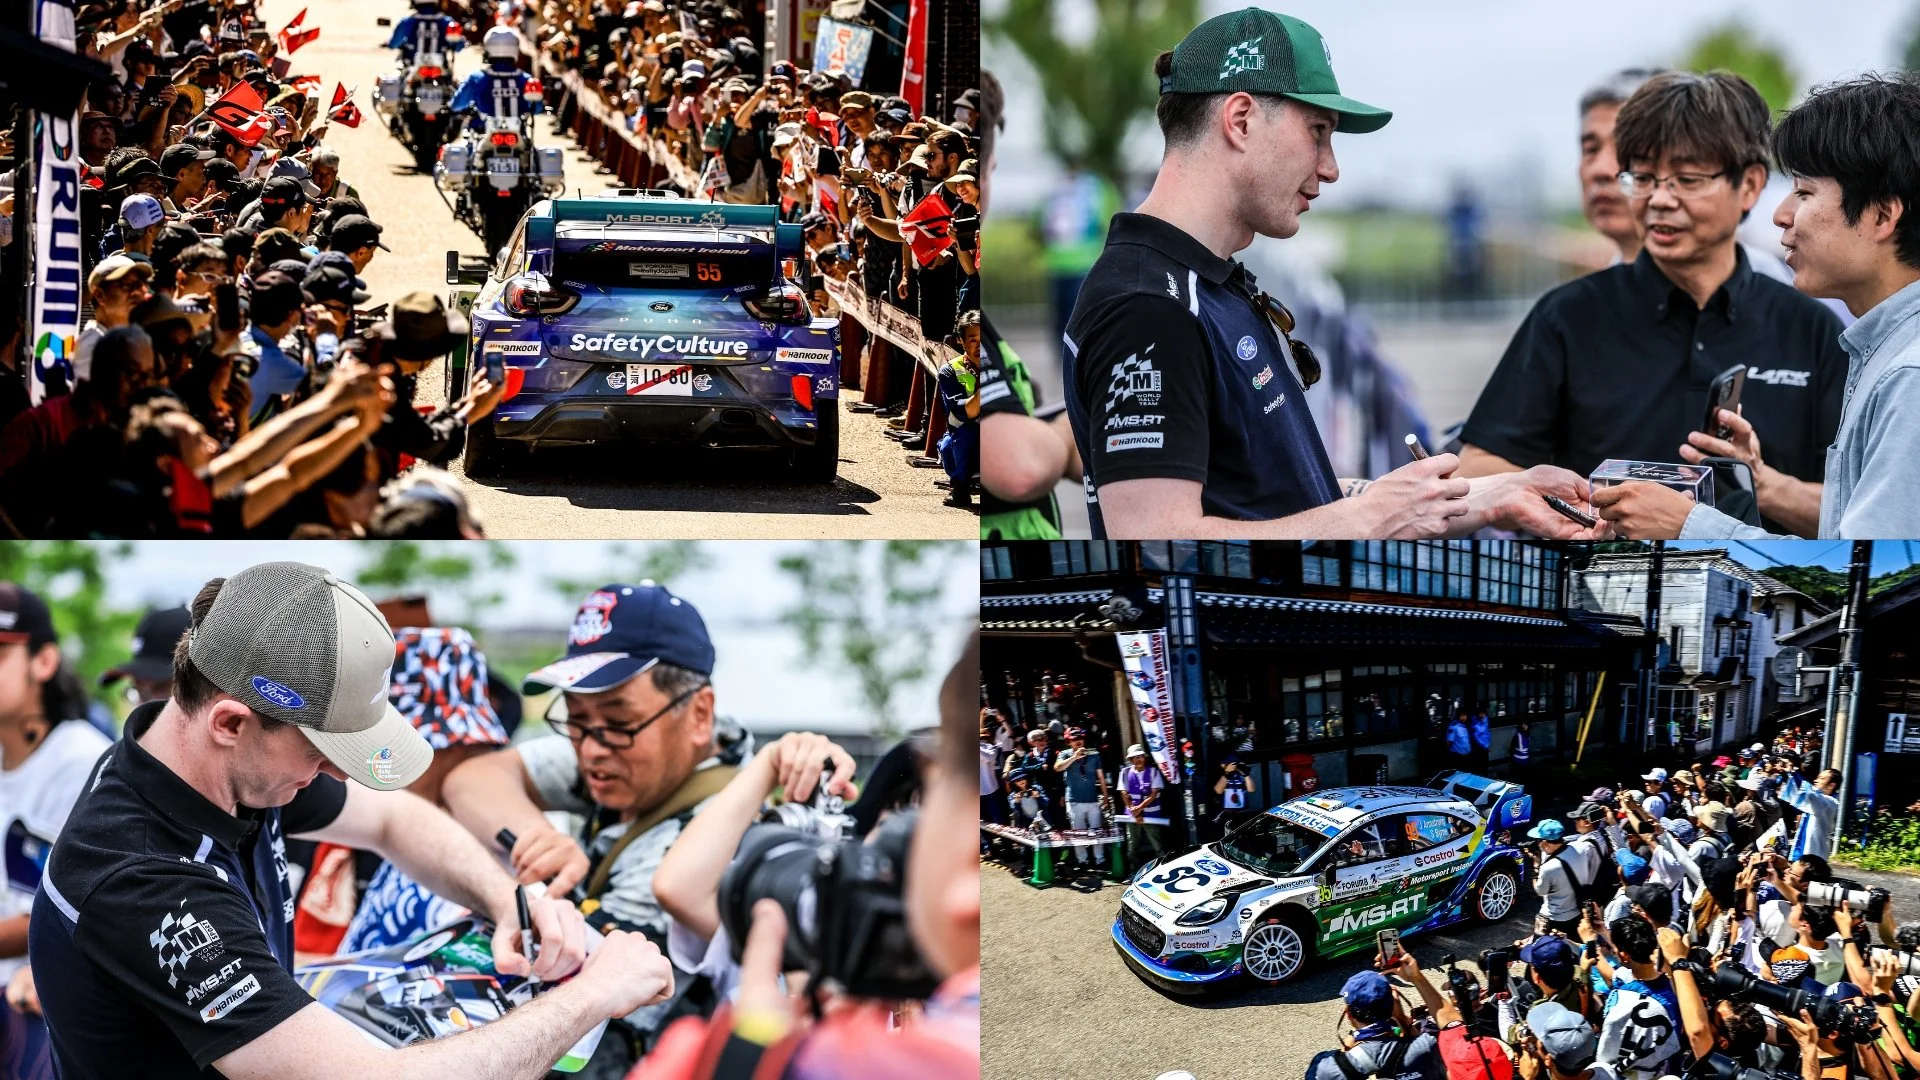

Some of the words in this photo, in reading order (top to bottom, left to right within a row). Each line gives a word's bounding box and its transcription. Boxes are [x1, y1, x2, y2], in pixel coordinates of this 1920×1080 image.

[607, 213, 694, 224] M-SPORT
[614, 244, 695, 254] Motorsport
[698, 247, 750, 255] Ireland
[697, 263, 722, 282] 55
[570, 333, 749, 359] SafetyCulture
[1114, 415, 1165, 427] MS-RT
[260, 682, 294, 705] Ford
[1423, 849, 1455, 864] Castrol
[1152, 867, 1210, 893] SC
[1410, 867, 1449, 885] Motorsport
[1450, 861, 1474, 875] Ireland
[1343, 893, 1424, 934] MS-RT
[1181, 941, 1210, 949] Castrol
[193, 957, 242, 998] MS-RT
